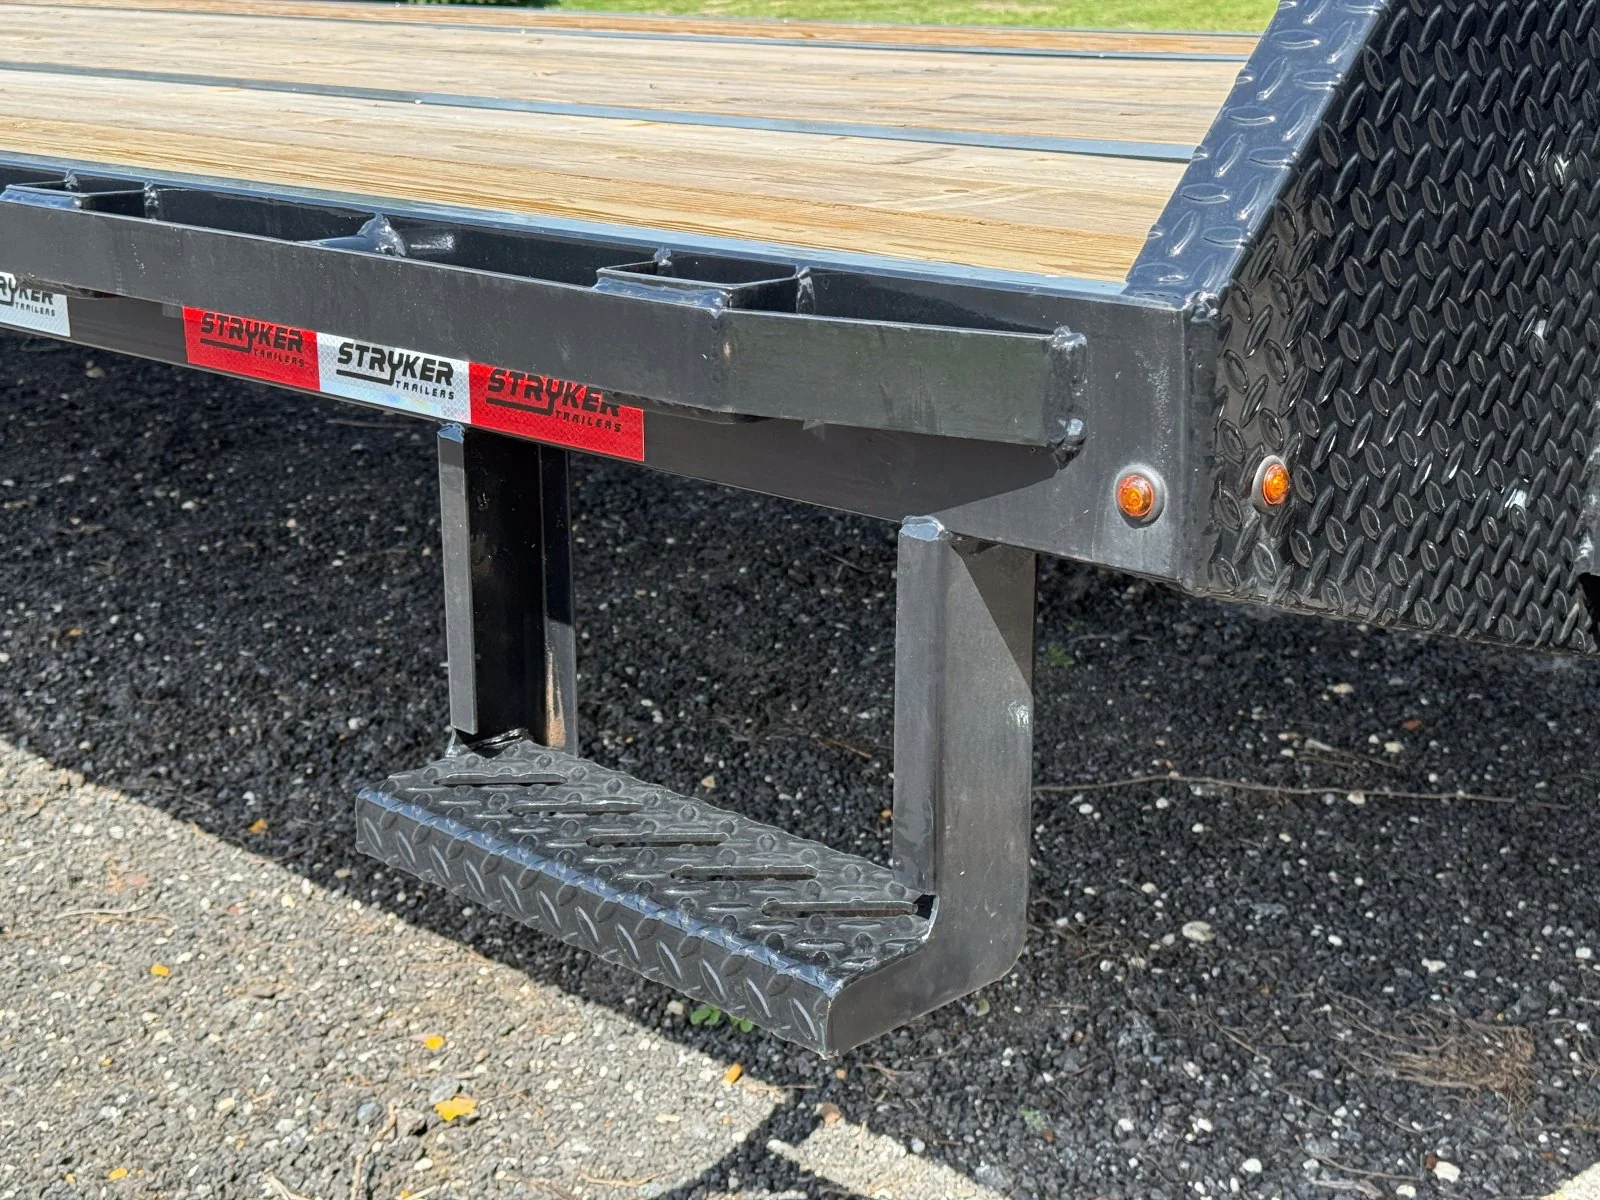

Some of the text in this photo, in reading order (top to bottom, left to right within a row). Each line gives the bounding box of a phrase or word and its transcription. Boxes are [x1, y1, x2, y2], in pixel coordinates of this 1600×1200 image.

[15, 302, 56, 317] TRAILERS
[200, 312, 303, 354] STRYKER
[253, 348, 305, 368] TRAILERS
[336, 341, 454, 387] STRYKER
[395, 380, 455, 400] TRAILERS
[555, 409, 623, 433] TRAILERS
